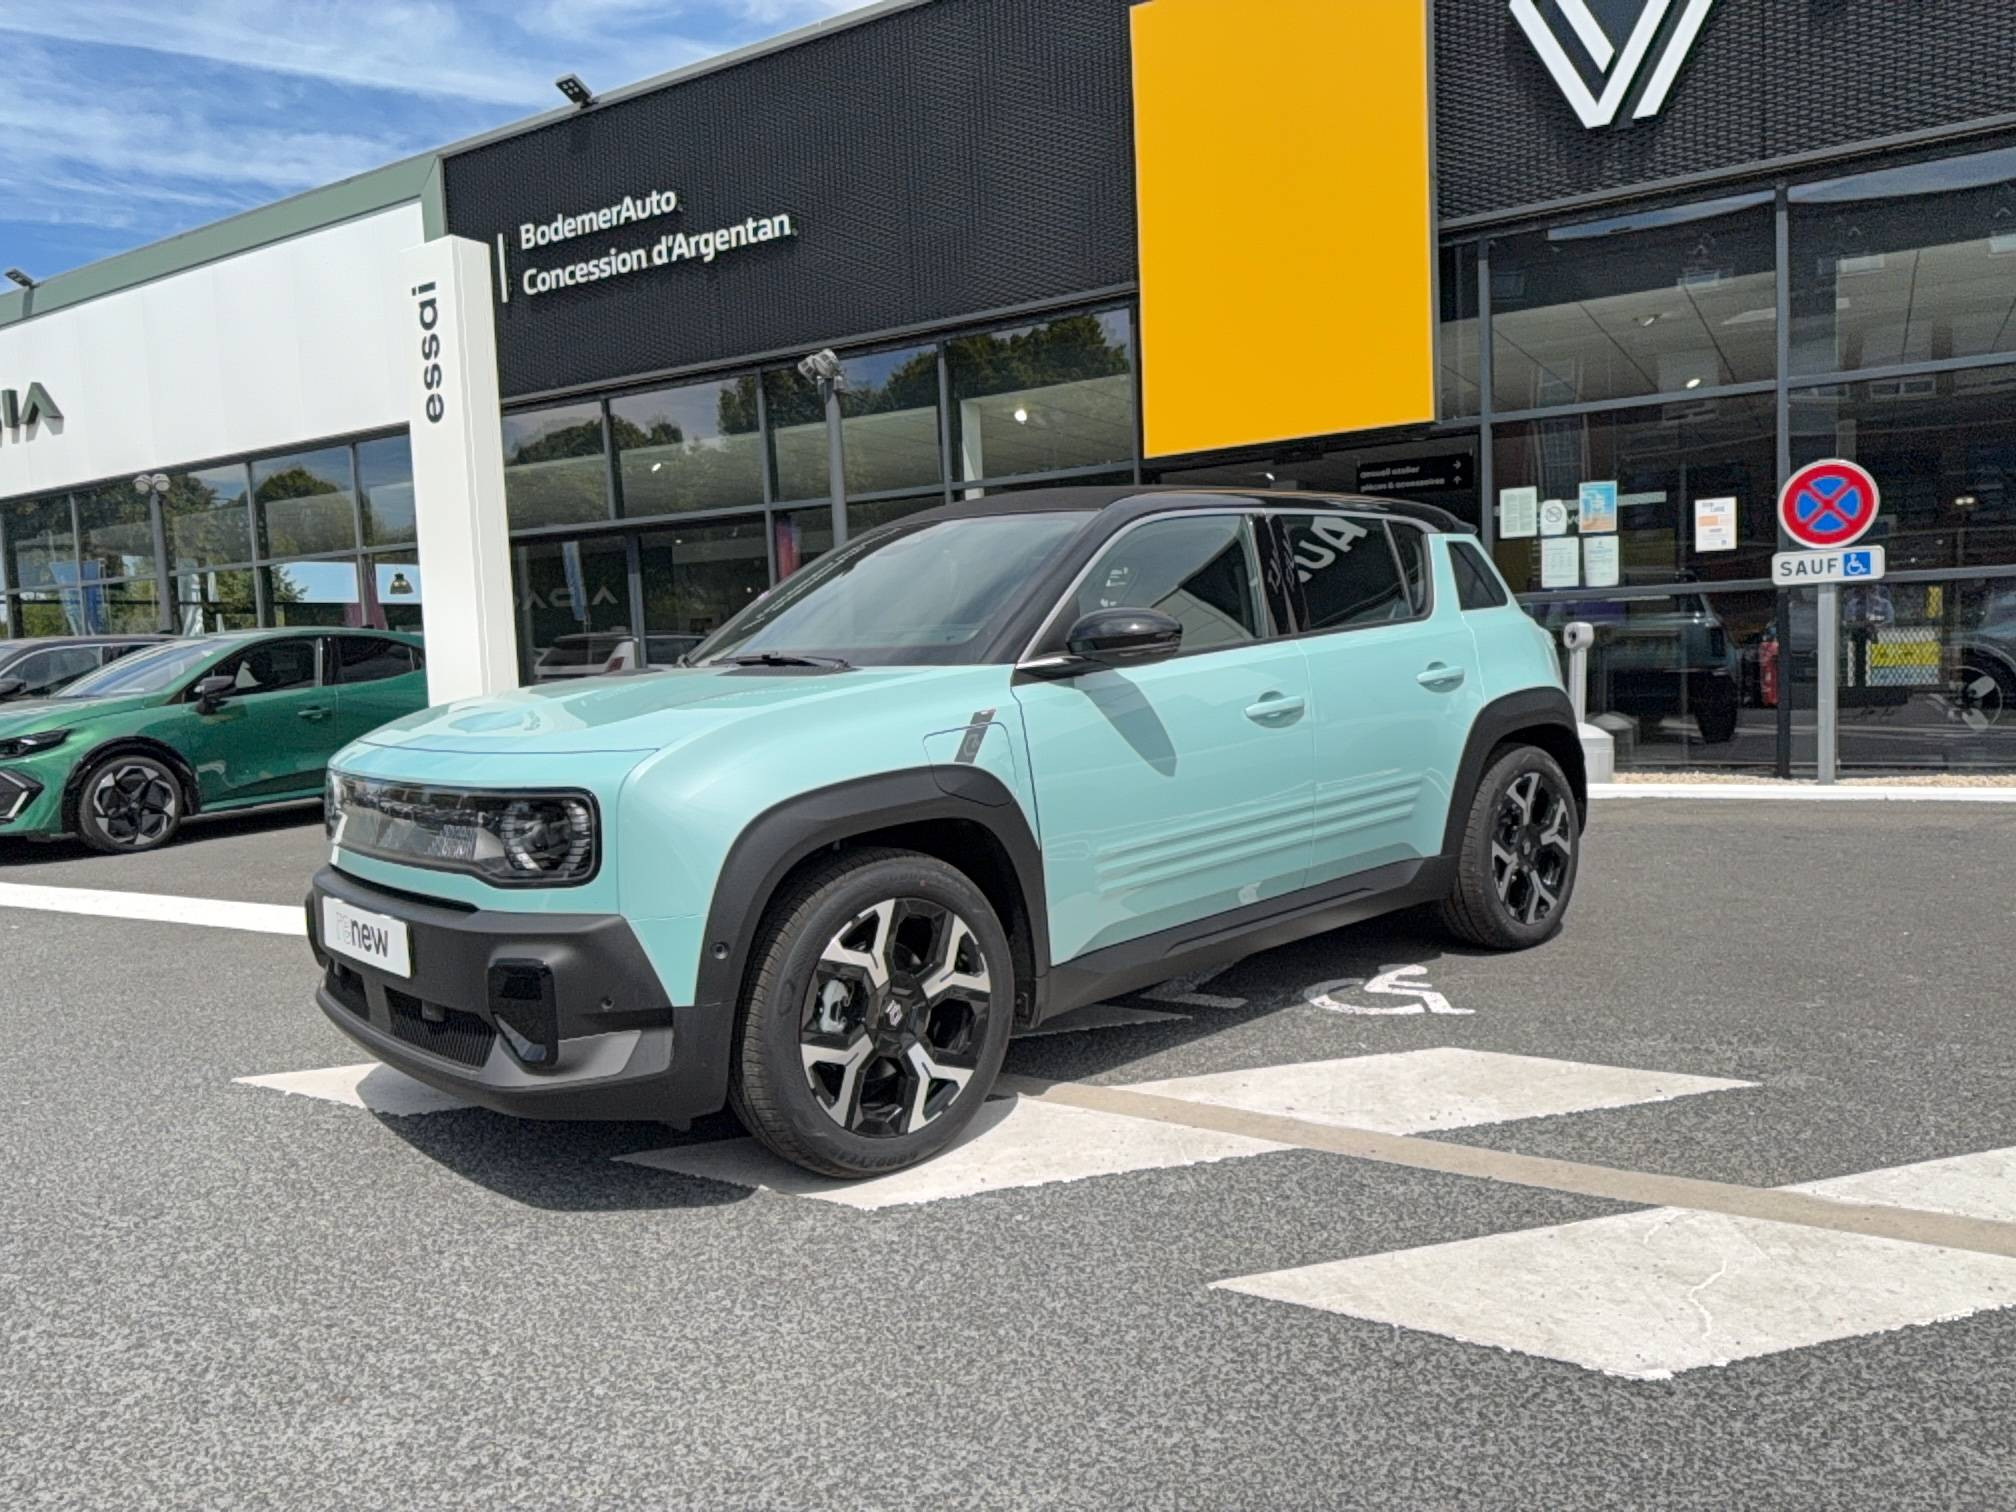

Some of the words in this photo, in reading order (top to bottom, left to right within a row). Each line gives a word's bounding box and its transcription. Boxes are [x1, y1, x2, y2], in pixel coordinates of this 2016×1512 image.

[519, 189, 678, 250] BodemerAuto
[523, 247, 648, 295] Concession
[651, 213, 792, 265] d'Argentan
[411, 281, 444, 424] essai
[1780, 558, 1838, 577] SAUF
